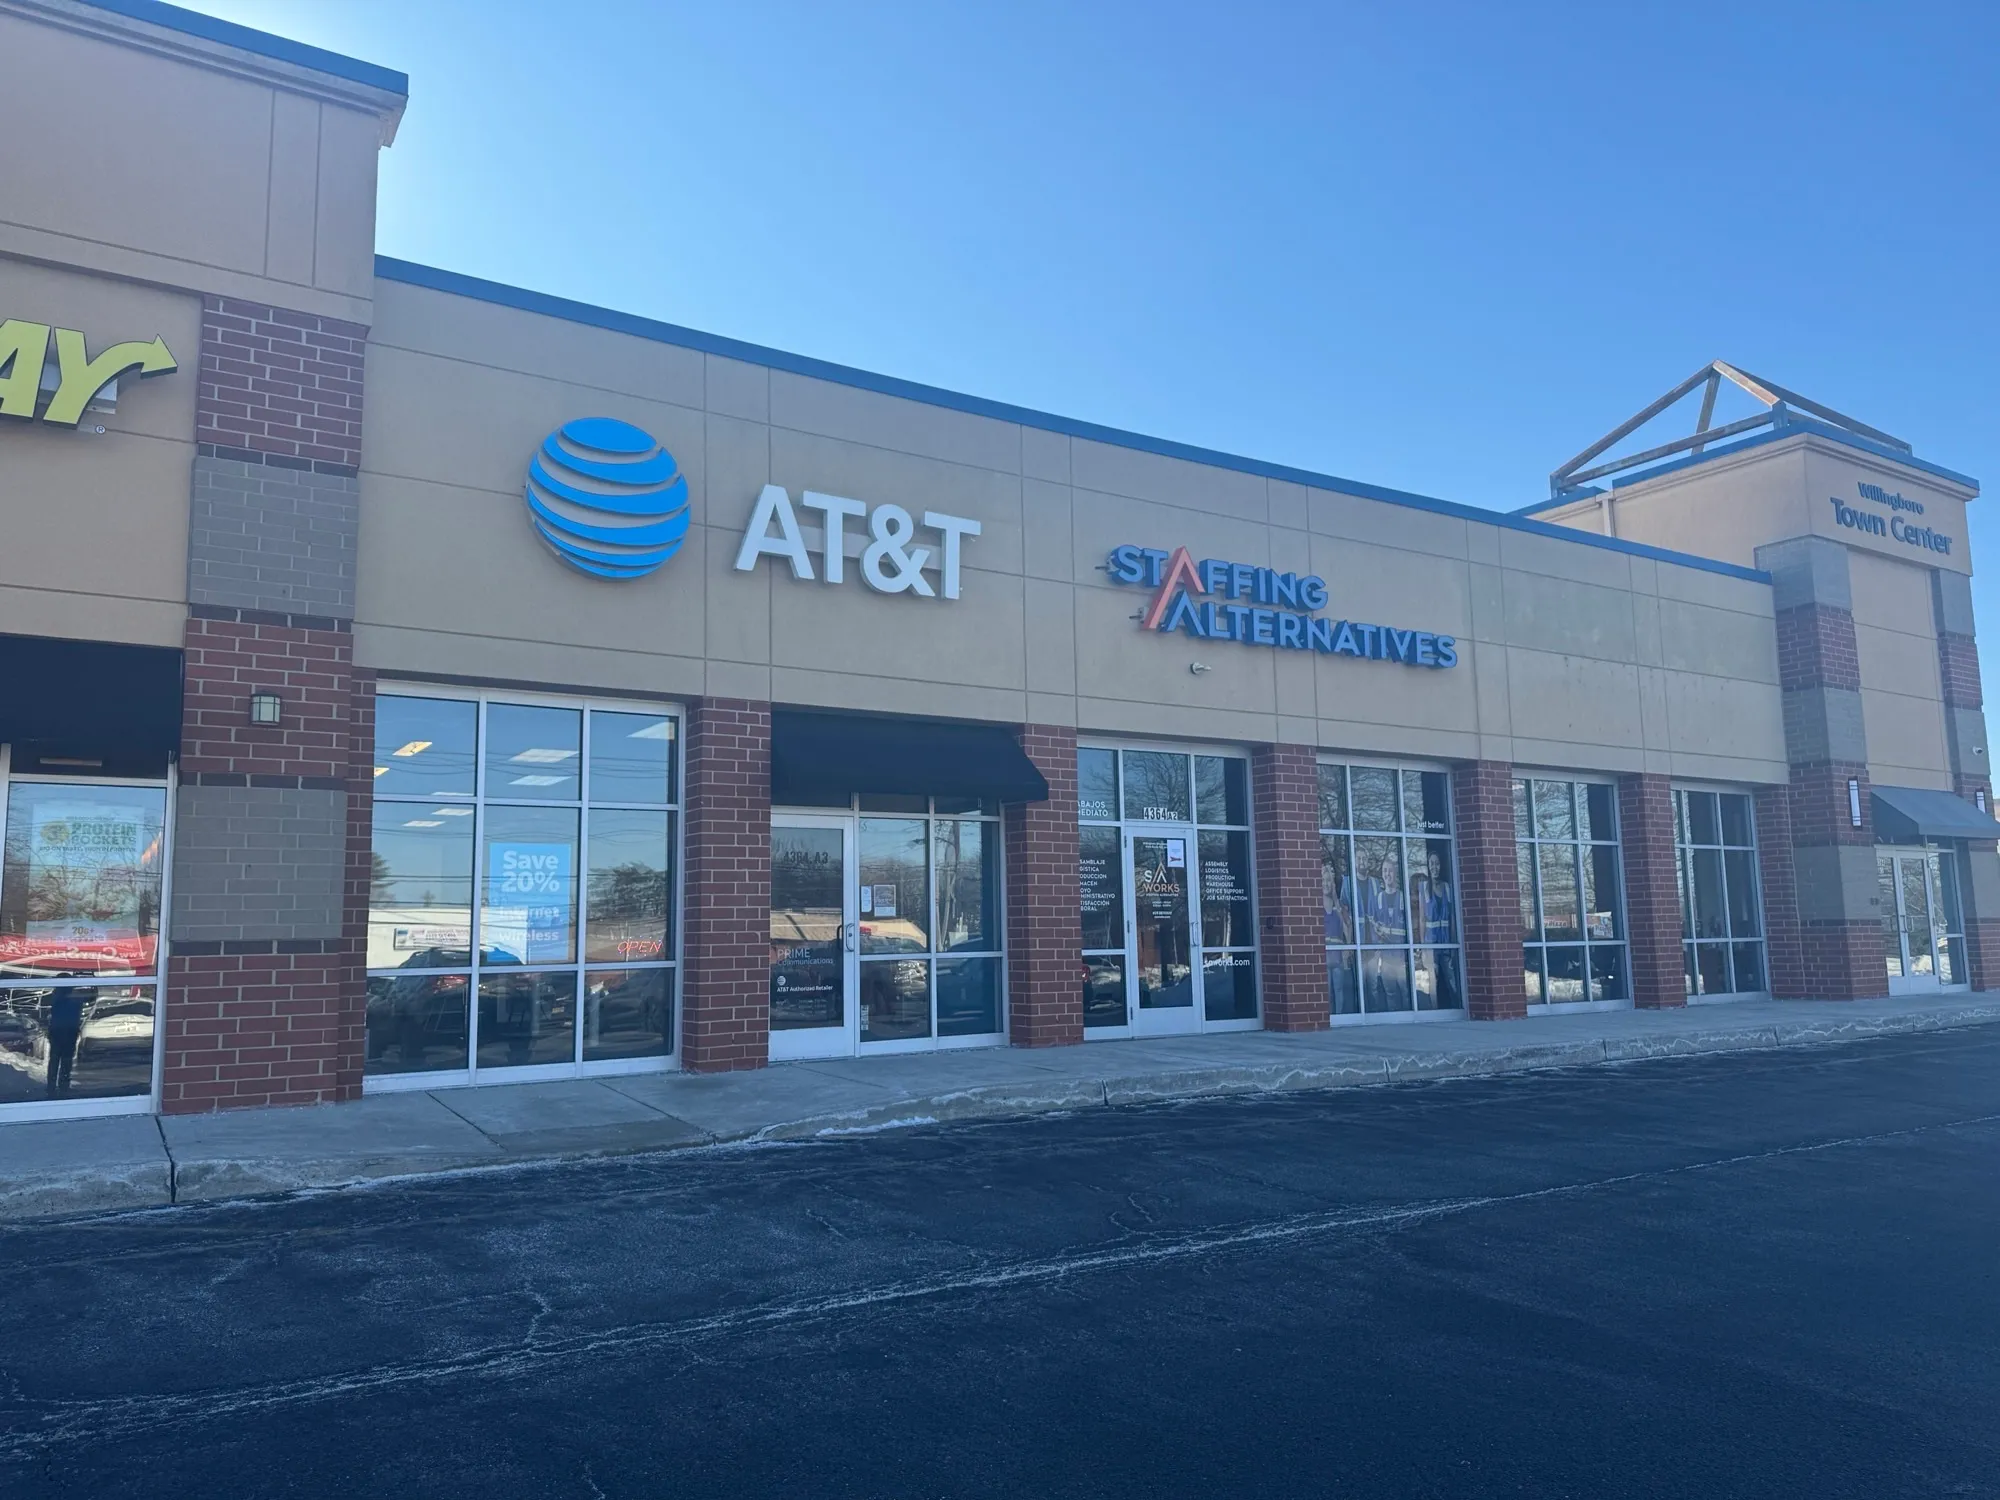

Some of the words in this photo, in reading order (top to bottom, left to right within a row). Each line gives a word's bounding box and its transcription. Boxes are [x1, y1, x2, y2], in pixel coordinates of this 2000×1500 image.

[1857, 482, 1925, 515] Willingboro
[1830, 497, 1886, 537] Town
[1891, 516, 1953, 555] Center
[733, 483, 981, 600] AT&T
[1112, 545, 1329, 629] STAFFING
[1160, 591, 1458, 669] ALTERNATIVES
[1143, 807, 1167, 820] 4364
[1167, 811, 1178, 820] A2
[71, 823, 136, 836] PROTEIN
[1428, 820, 1444, 829] better
[71, 836, 137, 845] POCKETS
[503, 851, 559, 870] Save
[501, 871, 560, 892] 20%
[1144, 883, 1180, 893] WORKS
[500, 930, 559, 941] wireless
[617, 941, 663, 952] OPEN
[777, 948, 811, 959] PRIME
[777, 958, 834, 966] Communications
